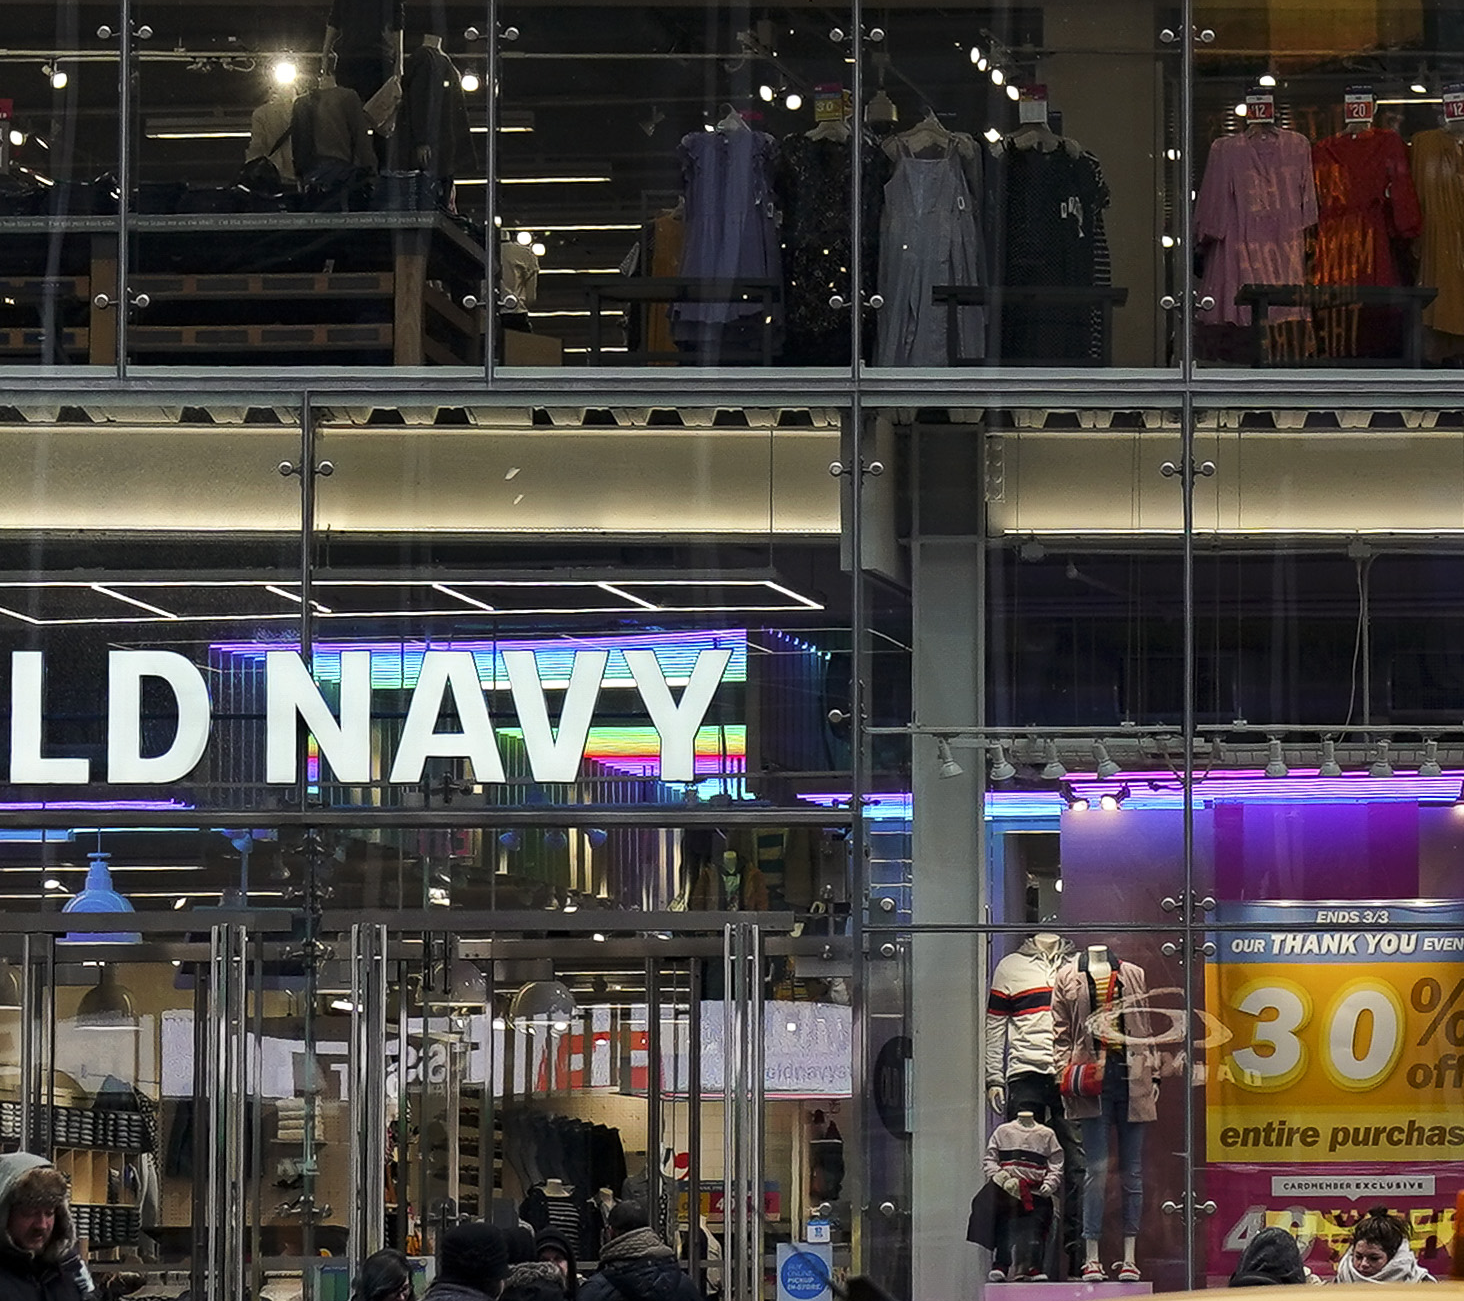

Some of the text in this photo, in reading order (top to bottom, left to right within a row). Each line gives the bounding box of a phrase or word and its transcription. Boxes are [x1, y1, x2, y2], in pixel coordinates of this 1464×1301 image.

[265, 649, 734, 785] NAVY
[1315, 910, 1389, 924] ENDS 3/3
[1231, 939, 1265, 953] OUR
[1271, 933, 1358, 955] THANK
[1365, 933, 1418, 955] YOU
[1220, 1120, 1320, 1148] entire
[1283, 1181, 1424, 1191] CARDMEMBER EXCLUSIVE
